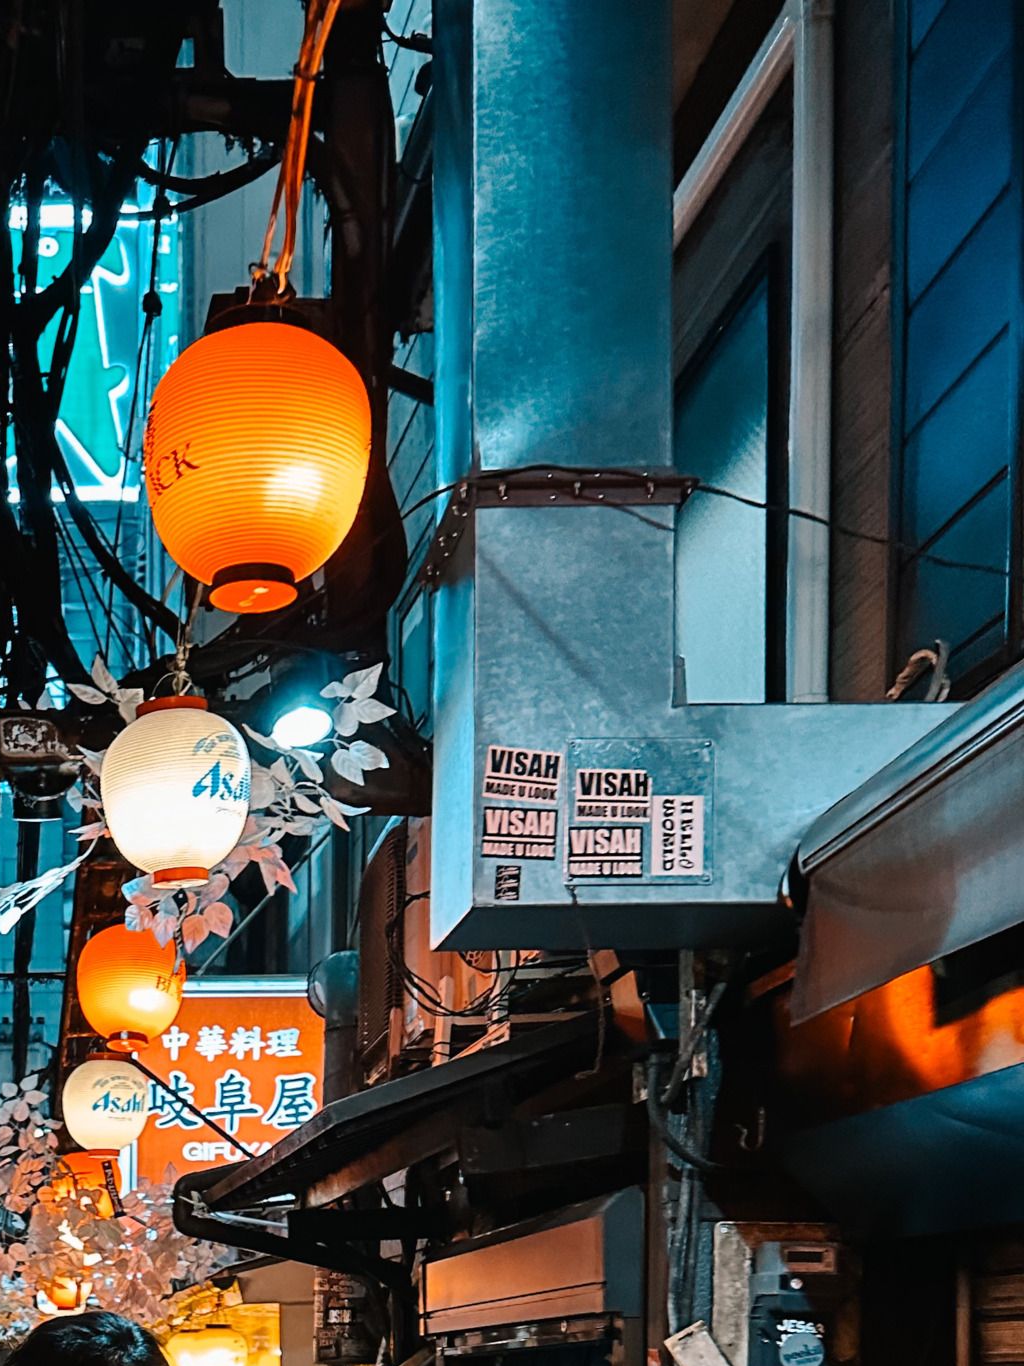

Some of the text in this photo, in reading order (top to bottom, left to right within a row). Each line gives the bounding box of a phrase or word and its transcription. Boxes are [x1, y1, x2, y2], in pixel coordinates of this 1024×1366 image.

[491, 749, 561, 780] VISAH
[485, 781, 557, 801] MADE U LOOK
[580, 772, 648, 797] VISAH
[484, 809, 556, 837] VISAH
[577, 804, 650, 818] MADE U LOOK
[570, 828, 642, 854] VISAH
[661, 798, 676, 872] WORLD
[482, 841, 556, 858] MADE U LOOK
[569, 861, 643, 876] MADE U LOOK
[161, 1025, 302, 1061] 中華料理
[91, 1090, 146, 1114] Asahi
[148, 1070, 317, 1132] 岐阜屋
